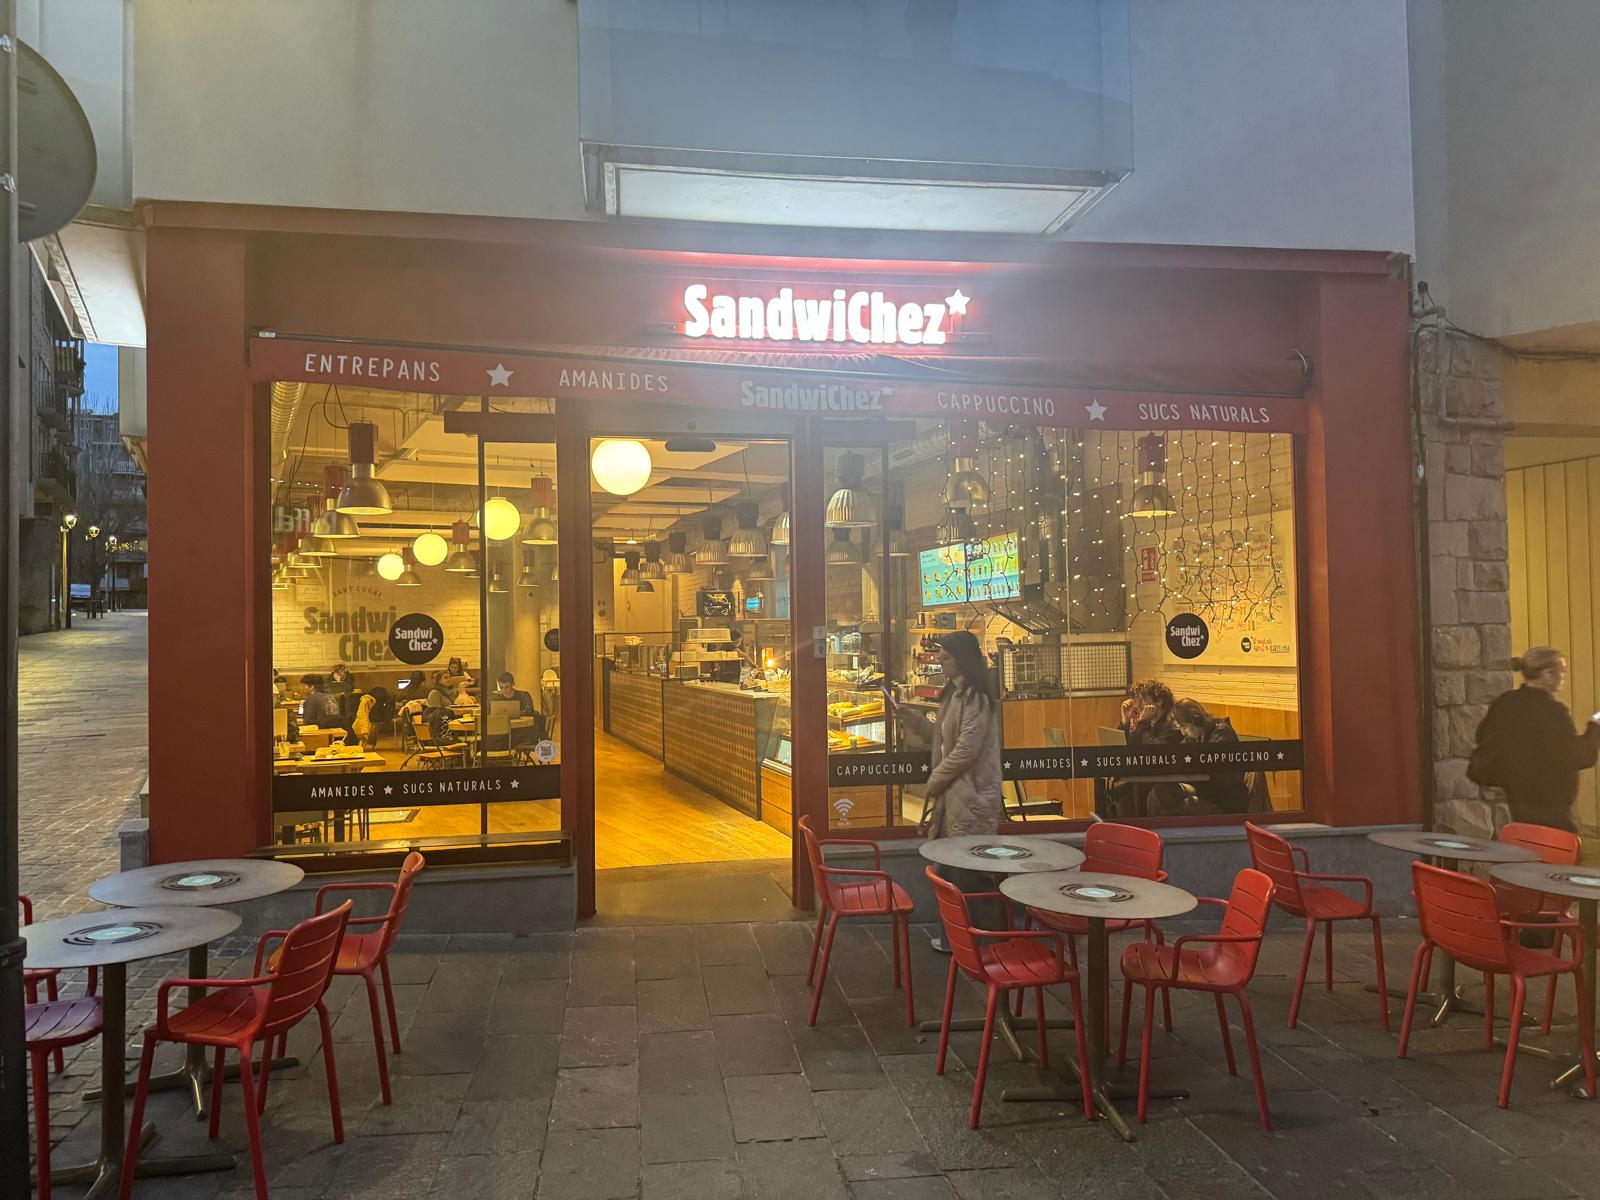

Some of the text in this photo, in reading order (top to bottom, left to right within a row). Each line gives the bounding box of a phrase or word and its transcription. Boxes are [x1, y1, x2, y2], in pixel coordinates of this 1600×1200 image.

[683, 284, 946, 345] SandwiChez
[304, 353, 440, 382] ENTREPANS
[559, 368, 669, 392] AMANIDES
[937, 392, 1055, 417] CAPPUCCINO
[1138, 403, 1271, 424] SUCS NATURALS
[303, 606, 397, 634] Sandwi
[395, 627, 433, 639] Sandwi
[1170, 625, 1200, 636] Sandwi
[408, 639, 433, 651] Chez
[1181, 636, 1200, 646] Chez
[1020, 758, 1071, 769] AMANIDES
[1096, 754, 1177, 767] SUCS NATURALS
[1199, 751, 1270, 764] CAPPUCCINO
[836, 763, 913, 776] CAPPUCCINO
[310, 785, 375, 798] AMANIDES
[403, 779, 502, 794] SUCS NATURALS
